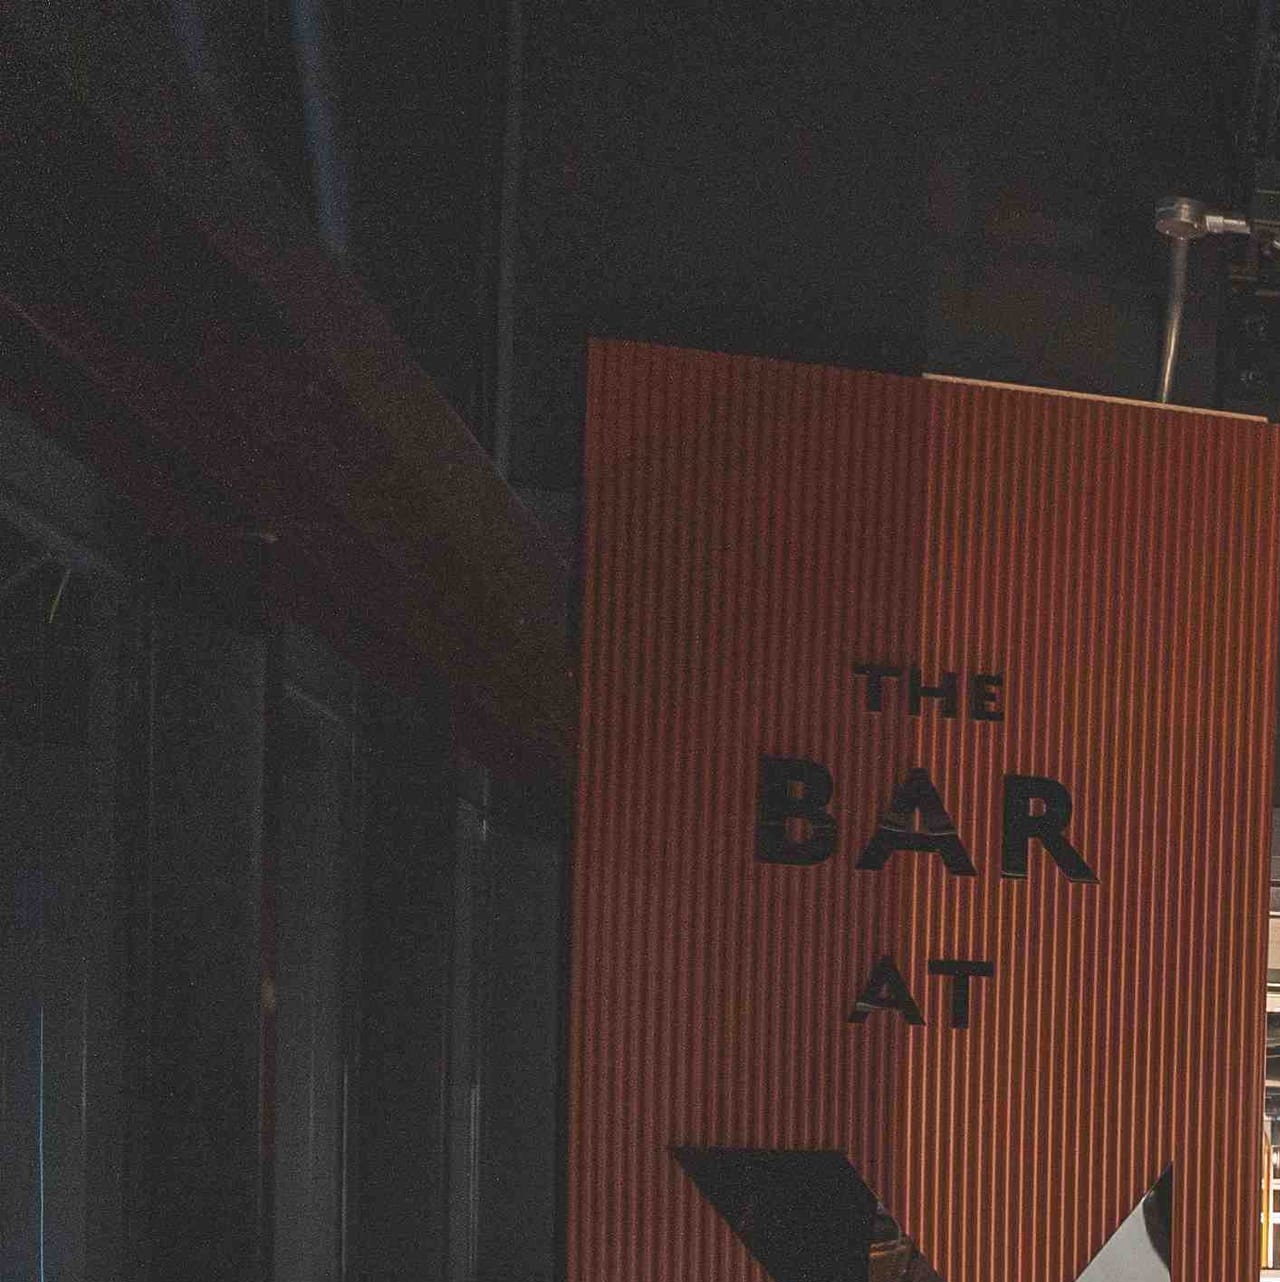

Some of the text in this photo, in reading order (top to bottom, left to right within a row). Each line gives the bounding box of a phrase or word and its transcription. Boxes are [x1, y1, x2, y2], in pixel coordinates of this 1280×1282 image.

[853, 663, 1004, 722] THE
[755, 753, 1100, 884] BAR
[846, 955, 993, 1029] AT
